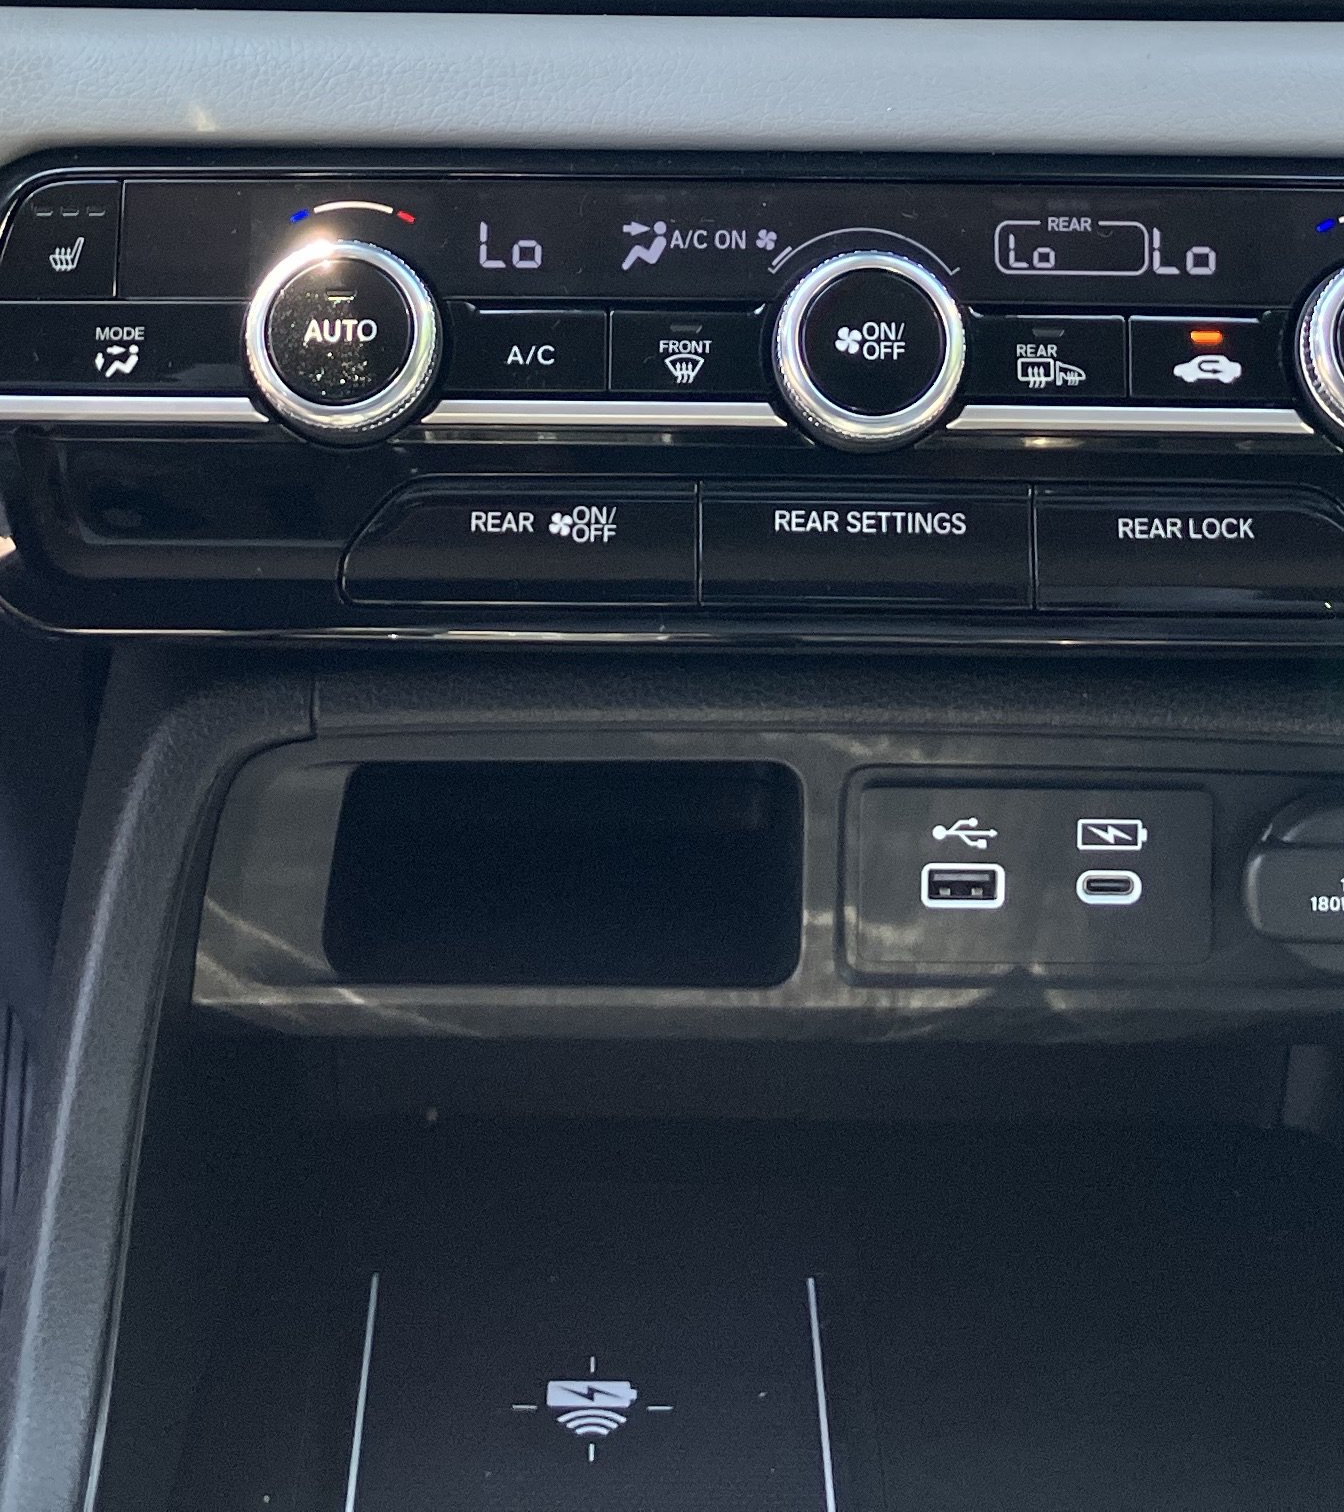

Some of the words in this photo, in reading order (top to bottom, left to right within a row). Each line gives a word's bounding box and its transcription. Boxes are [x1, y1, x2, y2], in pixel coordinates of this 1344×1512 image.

[1047, 216, 1092, 232] REAR
[669, 229, 708, 250] A/C
[714, 229, 747, 250] ON
[95, 326, 145, 341] MODE
[302, 318, 377, 347] AUTO
[862, 321, 905, 341] ON/
[506, 344, 555, 365] A/C
[659, 339, 712, 356] FRONT
[862, 340, 906, 361] OFF
[1016, 343, 1058, 361] REAR
[470, 511, 535, 533] REAR
[570, 505, 617, 526] ON/
[774, 510, 839, 533] REAR
[846, 511, 967, 535] SETTINGS
[571, 524, 617, 543] OFF
[1117, 517, 1183, 539] REAR
[1188, 517, 1255, 540] LOCK
